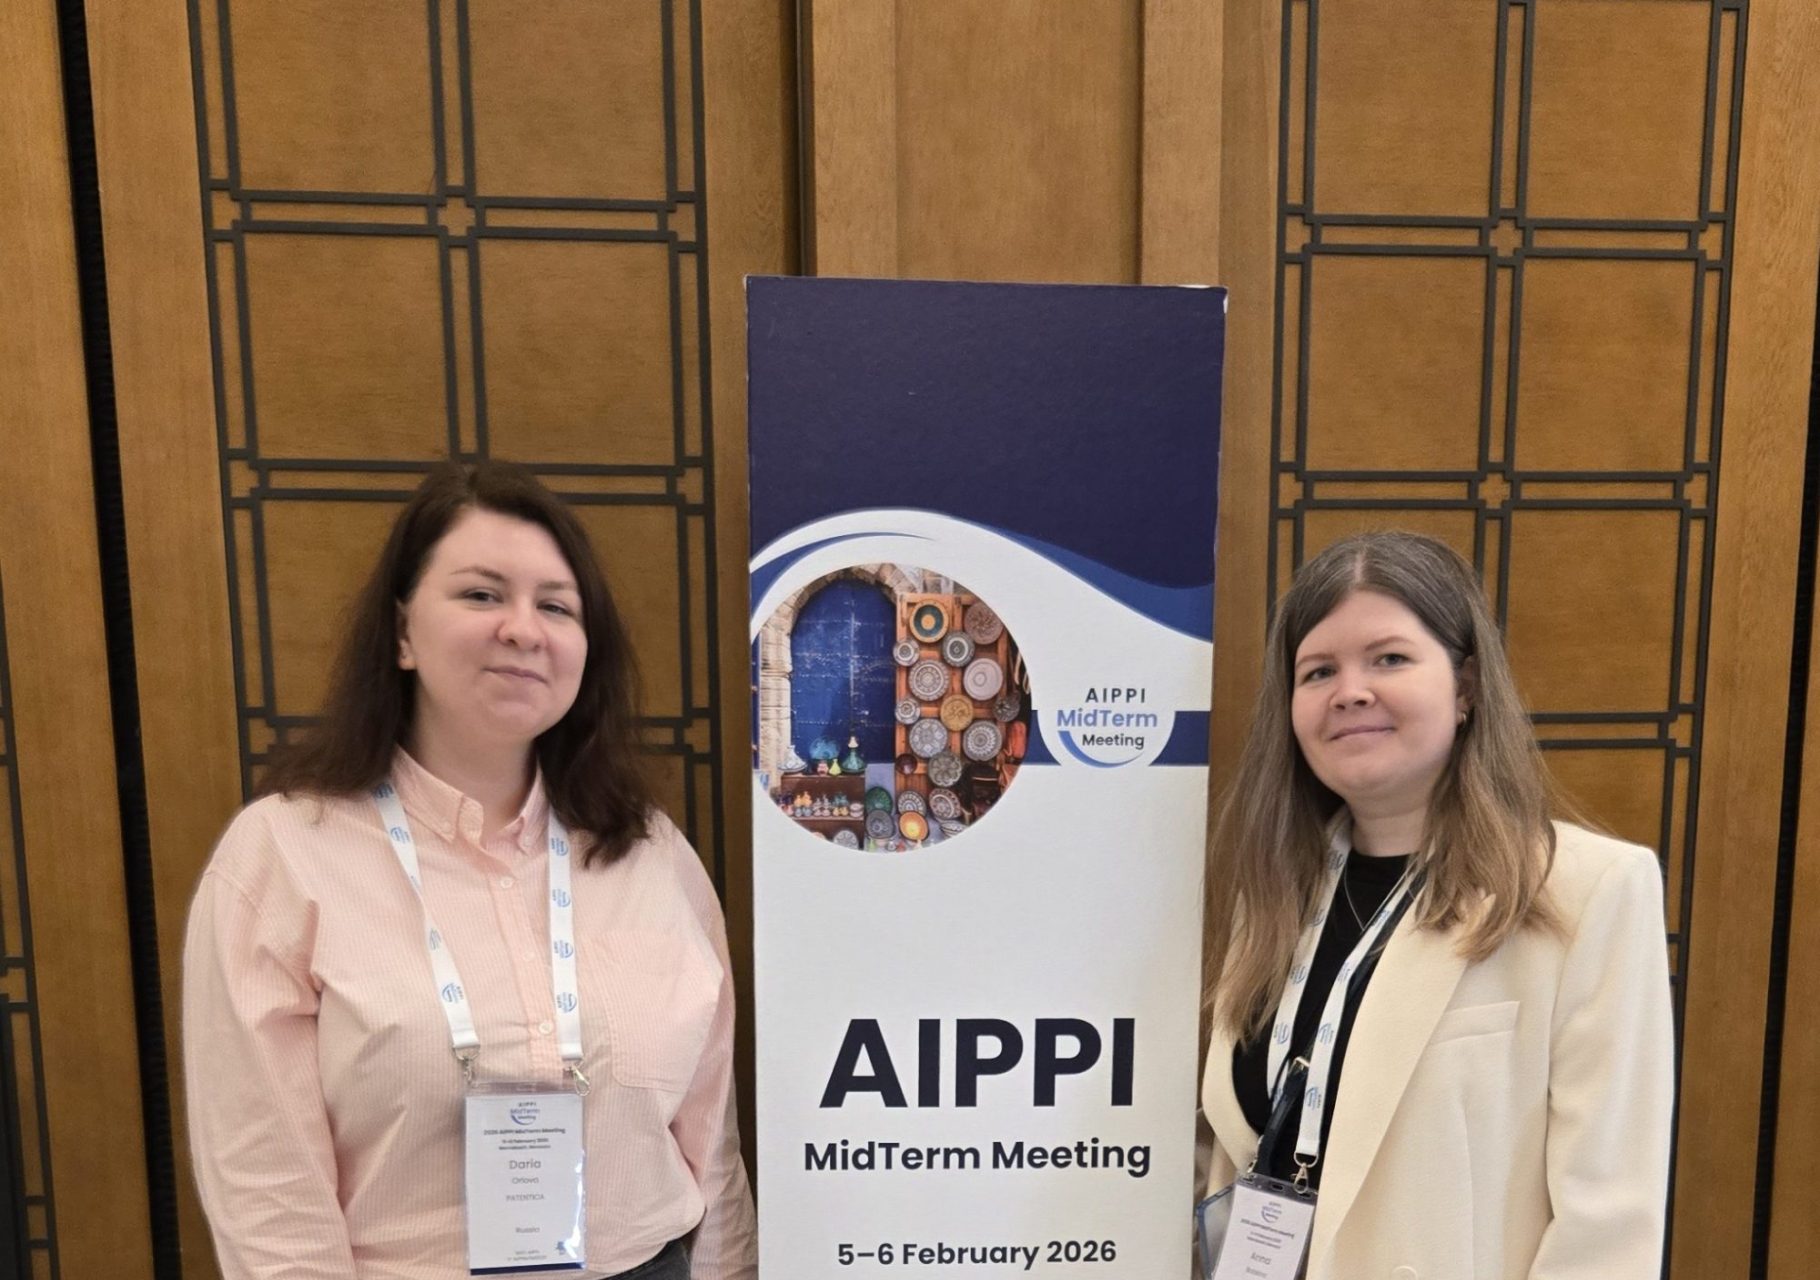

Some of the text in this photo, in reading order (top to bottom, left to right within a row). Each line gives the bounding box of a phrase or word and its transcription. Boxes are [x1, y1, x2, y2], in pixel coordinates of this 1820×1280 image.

[1086, 688, 1145, 703] AIPPI
[1058, 708, 1157, 727] MidTerm
[1083, 733, 1144, 750] Meeting
[820, 1018, 1135, 1108] AIPPI
[509, 1158, 541, 1169] Daria
[805, 1137, 1150, 1178] MidTerm Meeting
[903, 1243, 1039, 1270] February
[1047, 1240, 1116, 1262] 2026
